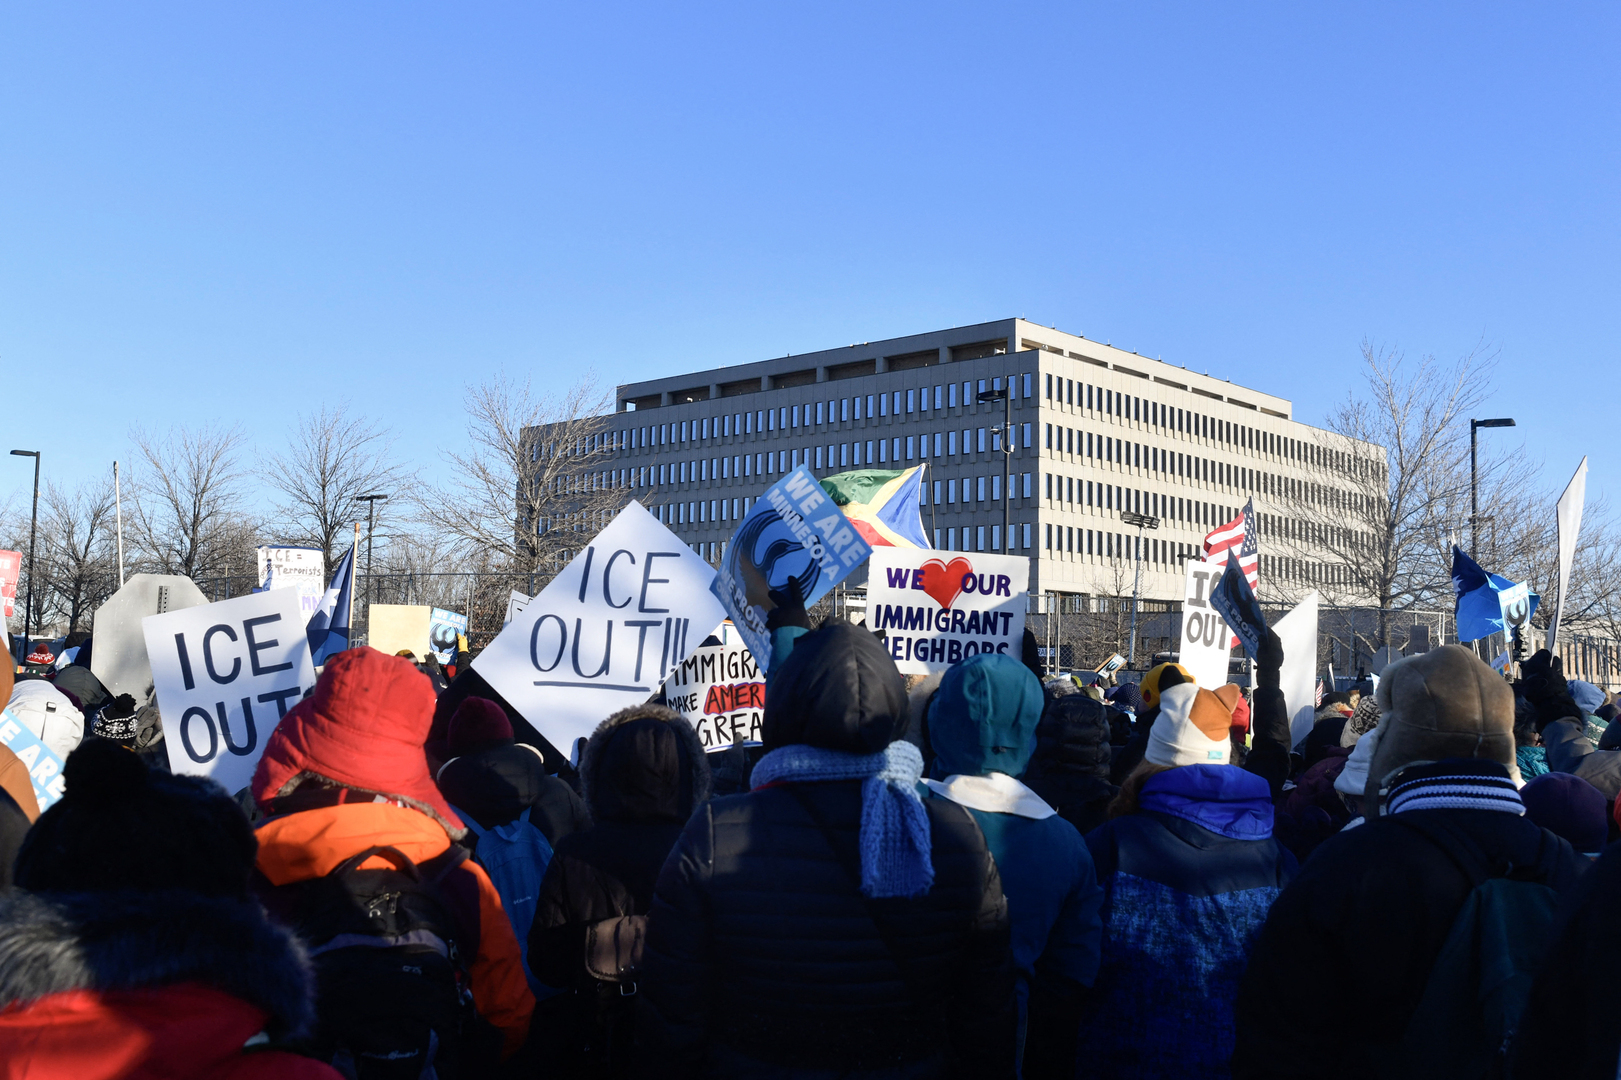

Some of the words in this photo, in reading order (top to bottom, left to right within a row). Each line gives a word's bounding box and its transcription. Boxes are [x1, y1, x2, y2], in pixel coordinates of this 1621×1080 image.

[766, 488, 840, 581] MINNESOTA
[785, 470, 825, 516] WE
[813, 514, 867, 567] ARE
[578, 546, 681, 613] ICE
[721, 565, 736, 592] WE
[886, 567, 925, 590] WE
[961, 572, 1011, 597] OUR
[434, 610, 448, 619] WE
[449, 614, 466, 624] ARE
[716, 581, 730, 605] OUR
[730, 602, 769, 666] NEIGHBORS
[875, 604, 1013, 636] IMMIGRANT
[1186, 611, 1228, 650] OUT
[1230, 608, 1259, 644] PROTE
[174, 613, 293, 691] ICE
[530, 613, 690, 685] OUT!!!
[668, 693, 698, 713] MAKE
[707, 684, 765, 713] AMER
[180, 687, 301, 763] OUT
[696, 712, 763, 746] GREA
[17, 744, 67, 800] ARE
